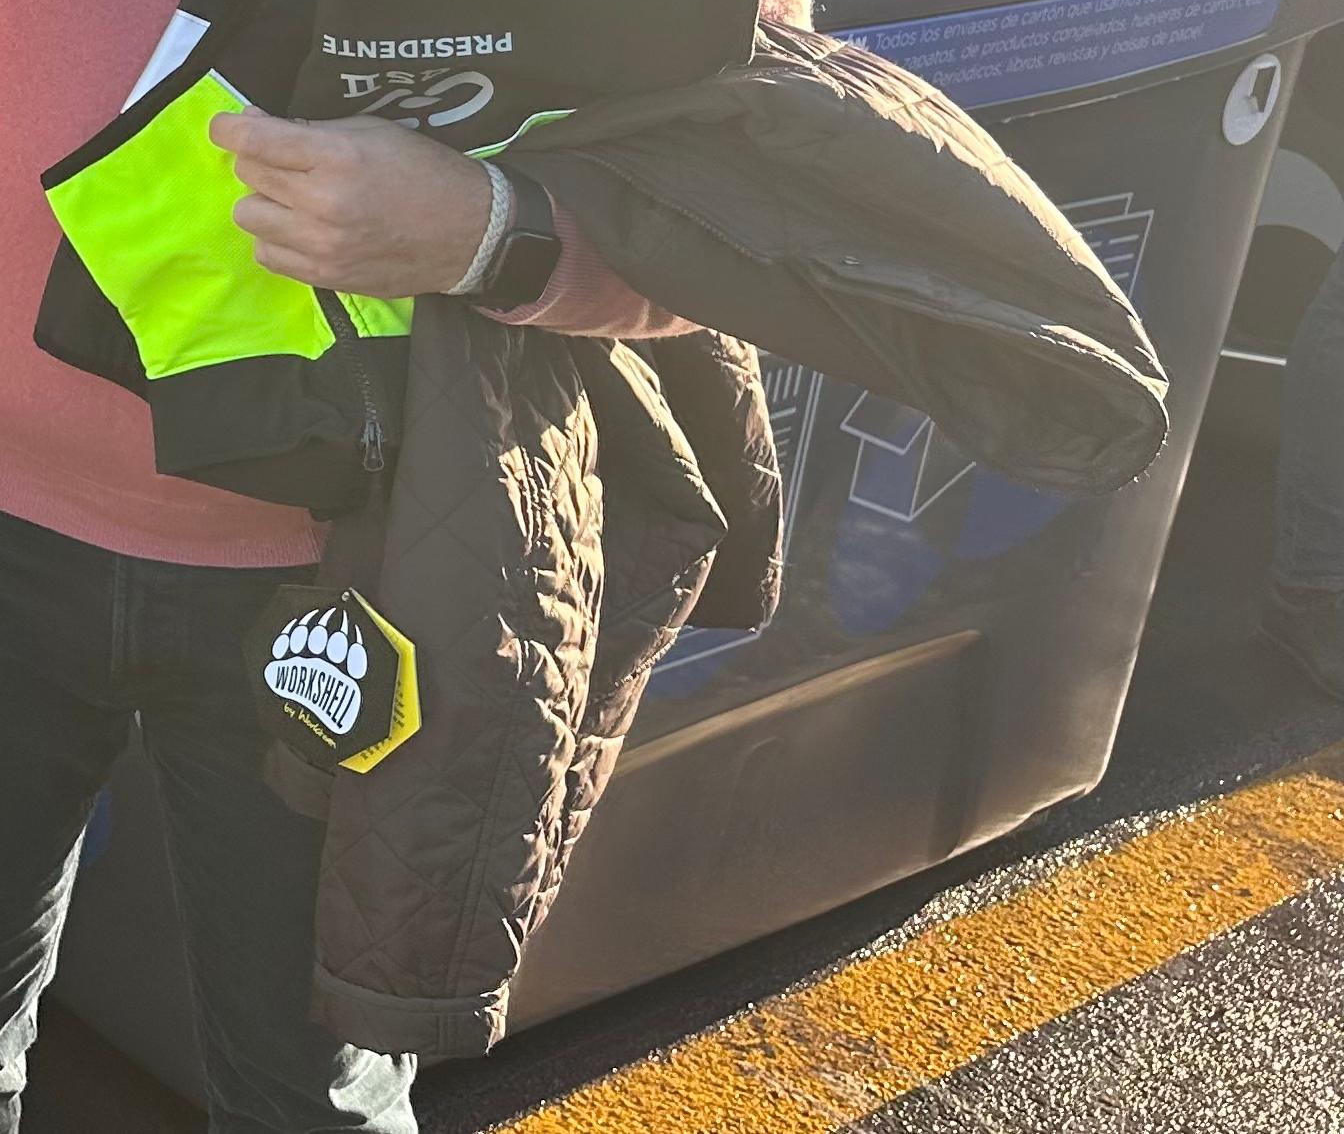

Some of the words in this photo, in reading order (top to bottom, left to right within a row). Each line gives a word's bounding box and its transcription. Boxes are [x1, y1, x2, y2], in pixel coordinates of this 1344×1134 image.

[875, 32, 916, 51] Todos
[920, 27, 940, 44] los
[943, 19, 998, 40] envases
[1001, 12, 1020, 29] de
[1067, 1, 1092, 19] que
[322, 31, 513, 59] PRESIDENTE
[961, 41, 980, 58] de
[981, 29, 1050, 55] productos
[275, 665, 356, 729] WORKSHELL
[283, 702, 296, 719] by
